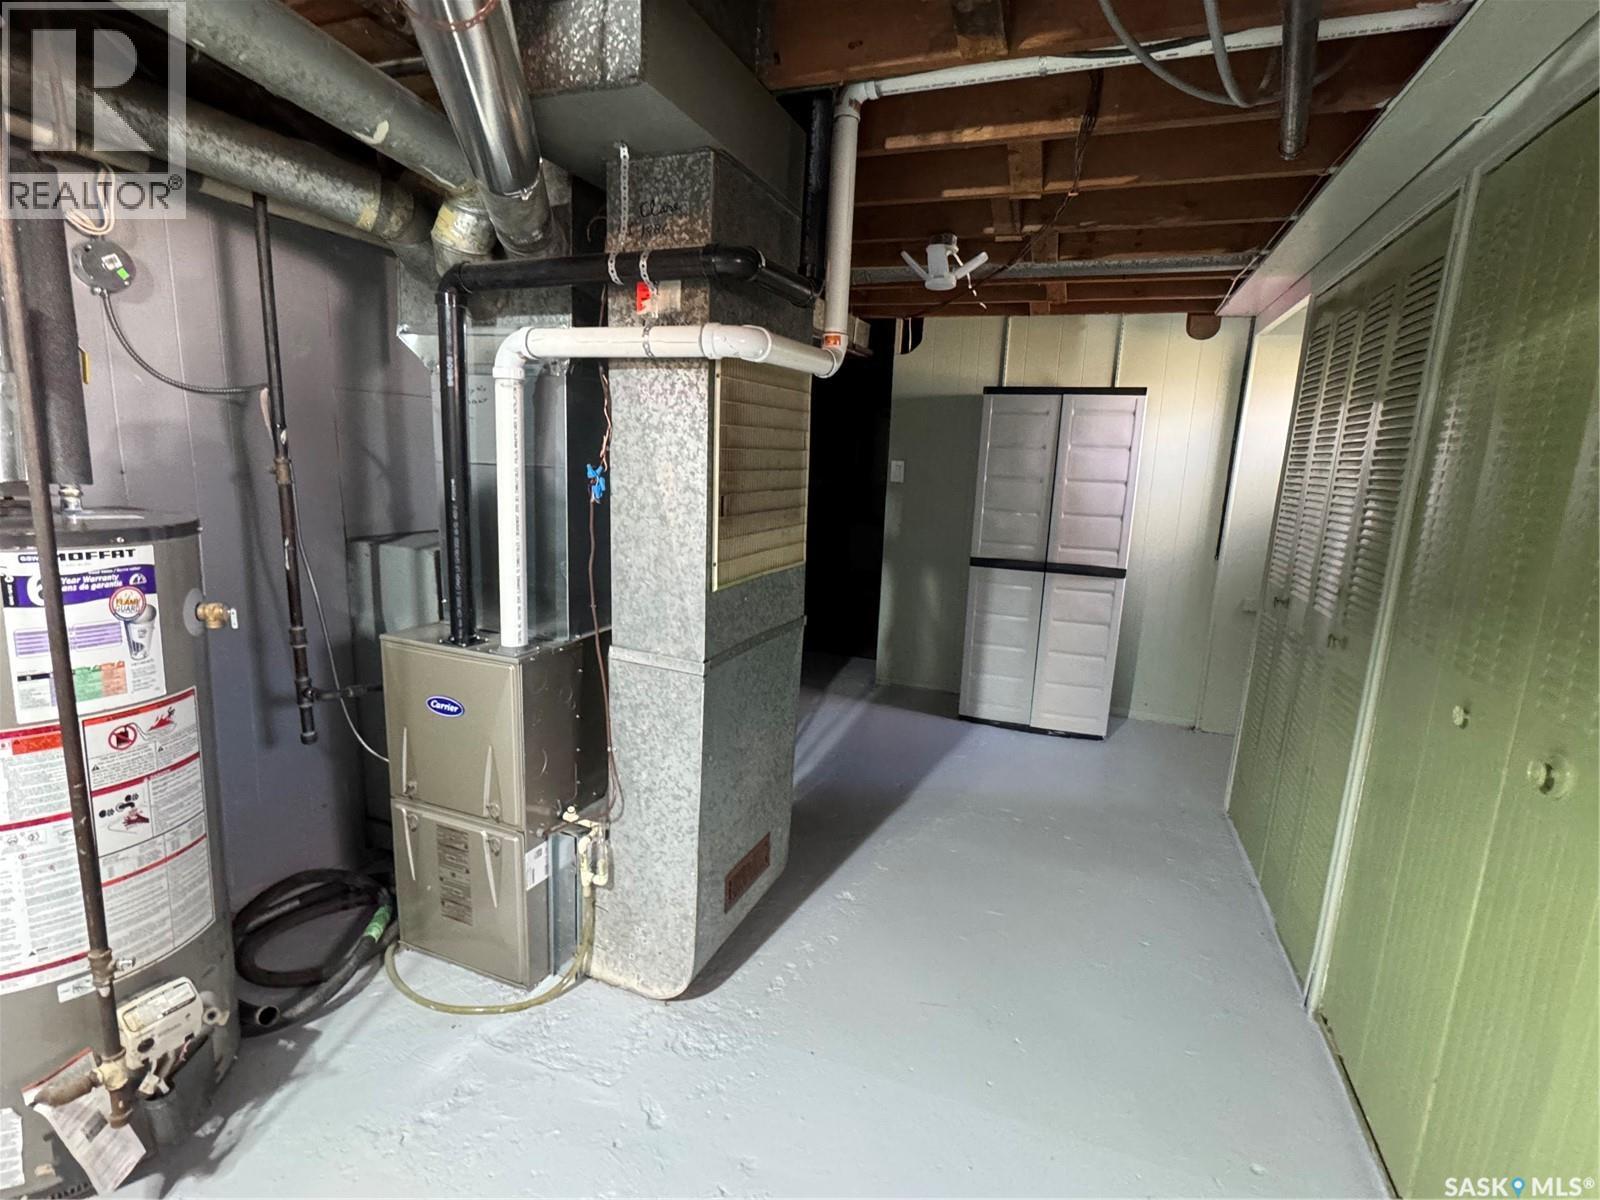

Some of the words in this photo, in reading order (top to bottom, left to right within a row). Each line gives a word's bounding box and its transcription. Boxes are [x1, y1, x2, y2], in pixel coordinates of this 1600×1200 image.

[61, 577, 81, 585] Year
[83, 574, 120, 583] Warranty
[79, 583, 89, 591] de
[90, 581, 123, 591] garantie
[430, 699, 459, 712] Carrier
